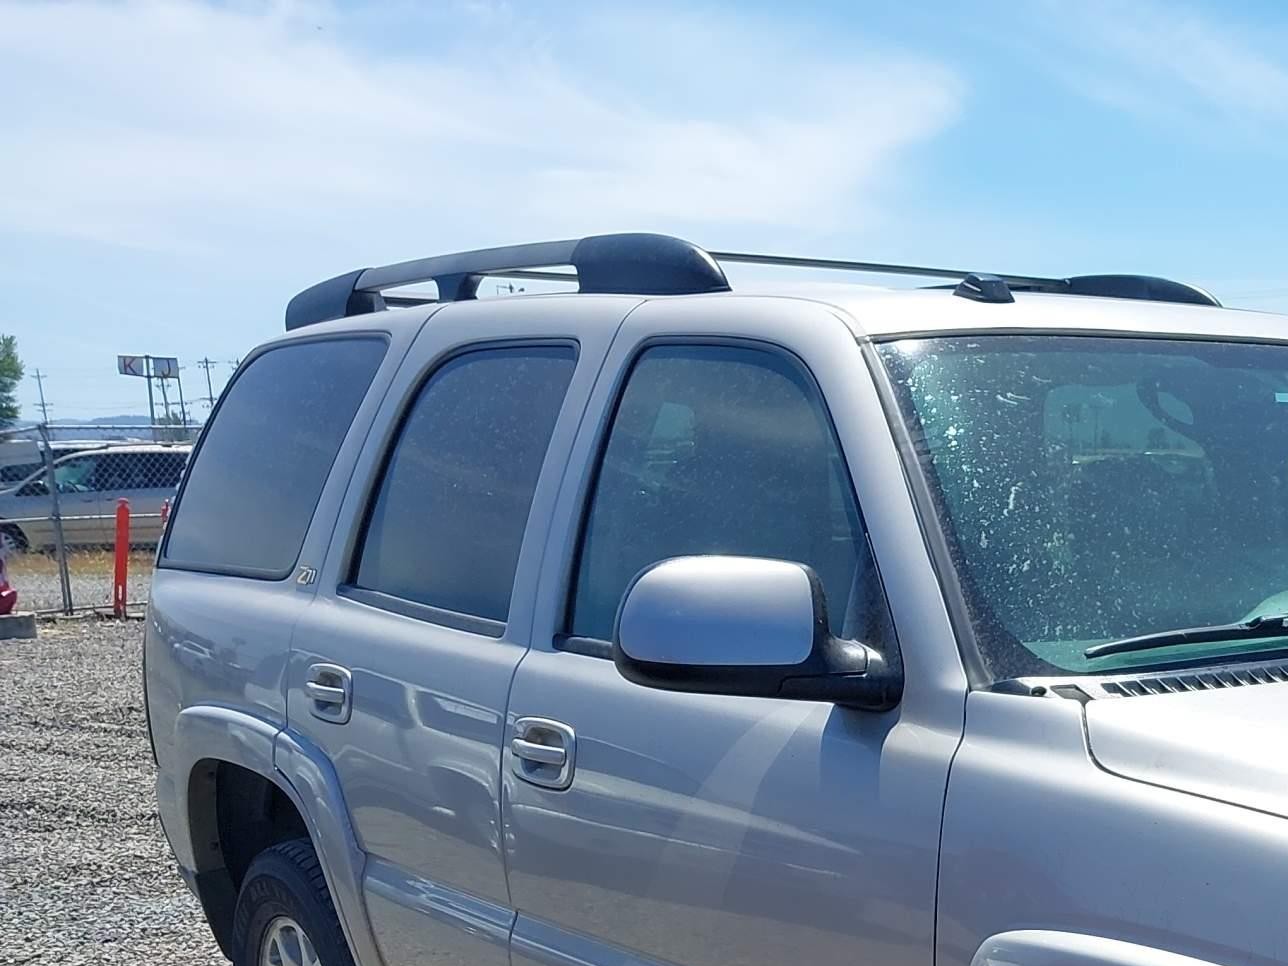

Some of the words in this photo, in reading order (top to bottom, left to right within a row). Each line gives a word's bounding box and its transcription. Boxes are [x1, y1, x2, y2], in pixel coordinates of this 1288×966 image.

[122, 358, 137, 374] K
[161, 359, 171, 378] J
[296, 566, 318, 585] Z71
